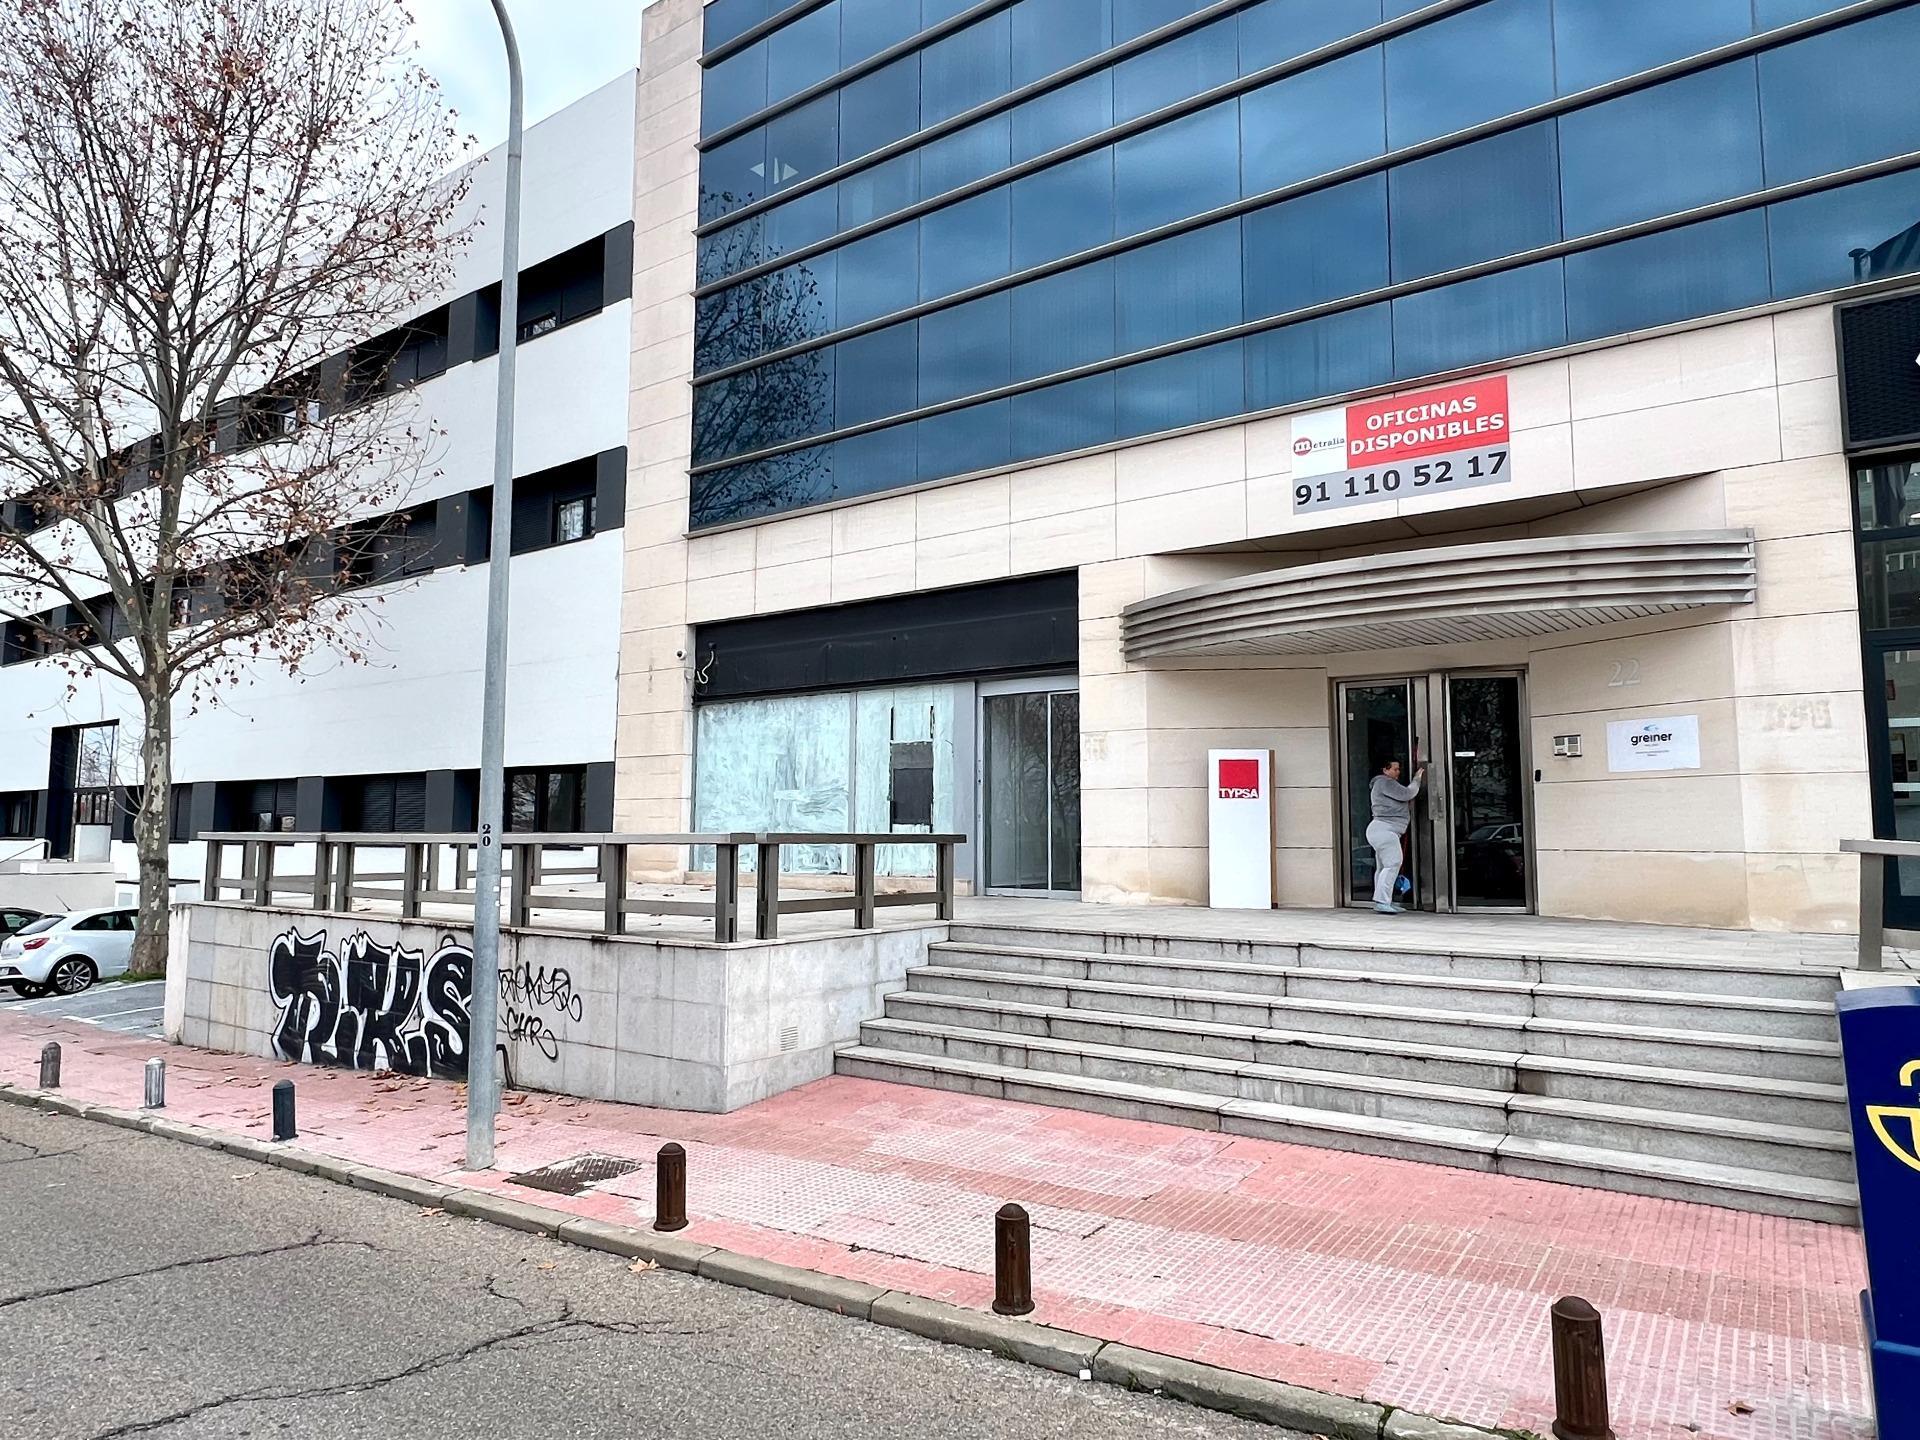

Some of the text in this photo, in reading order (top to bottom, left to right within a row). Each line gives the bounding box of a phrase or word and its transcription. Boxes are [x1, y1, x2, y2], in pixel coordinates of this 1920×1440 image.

[1366, 396, 1478, 430] OFICINAS
[1350, 413, 1505, 456] DISPONIBLES
[1295, 451, 1508, 506] 91 110 52 17
[1608, 659, 1641, 687] 22
[1631, 733, 1672, 746] greiner
[1220, 788, 1258, 798] TYPSA
[482, 823, 491, 847] 20
